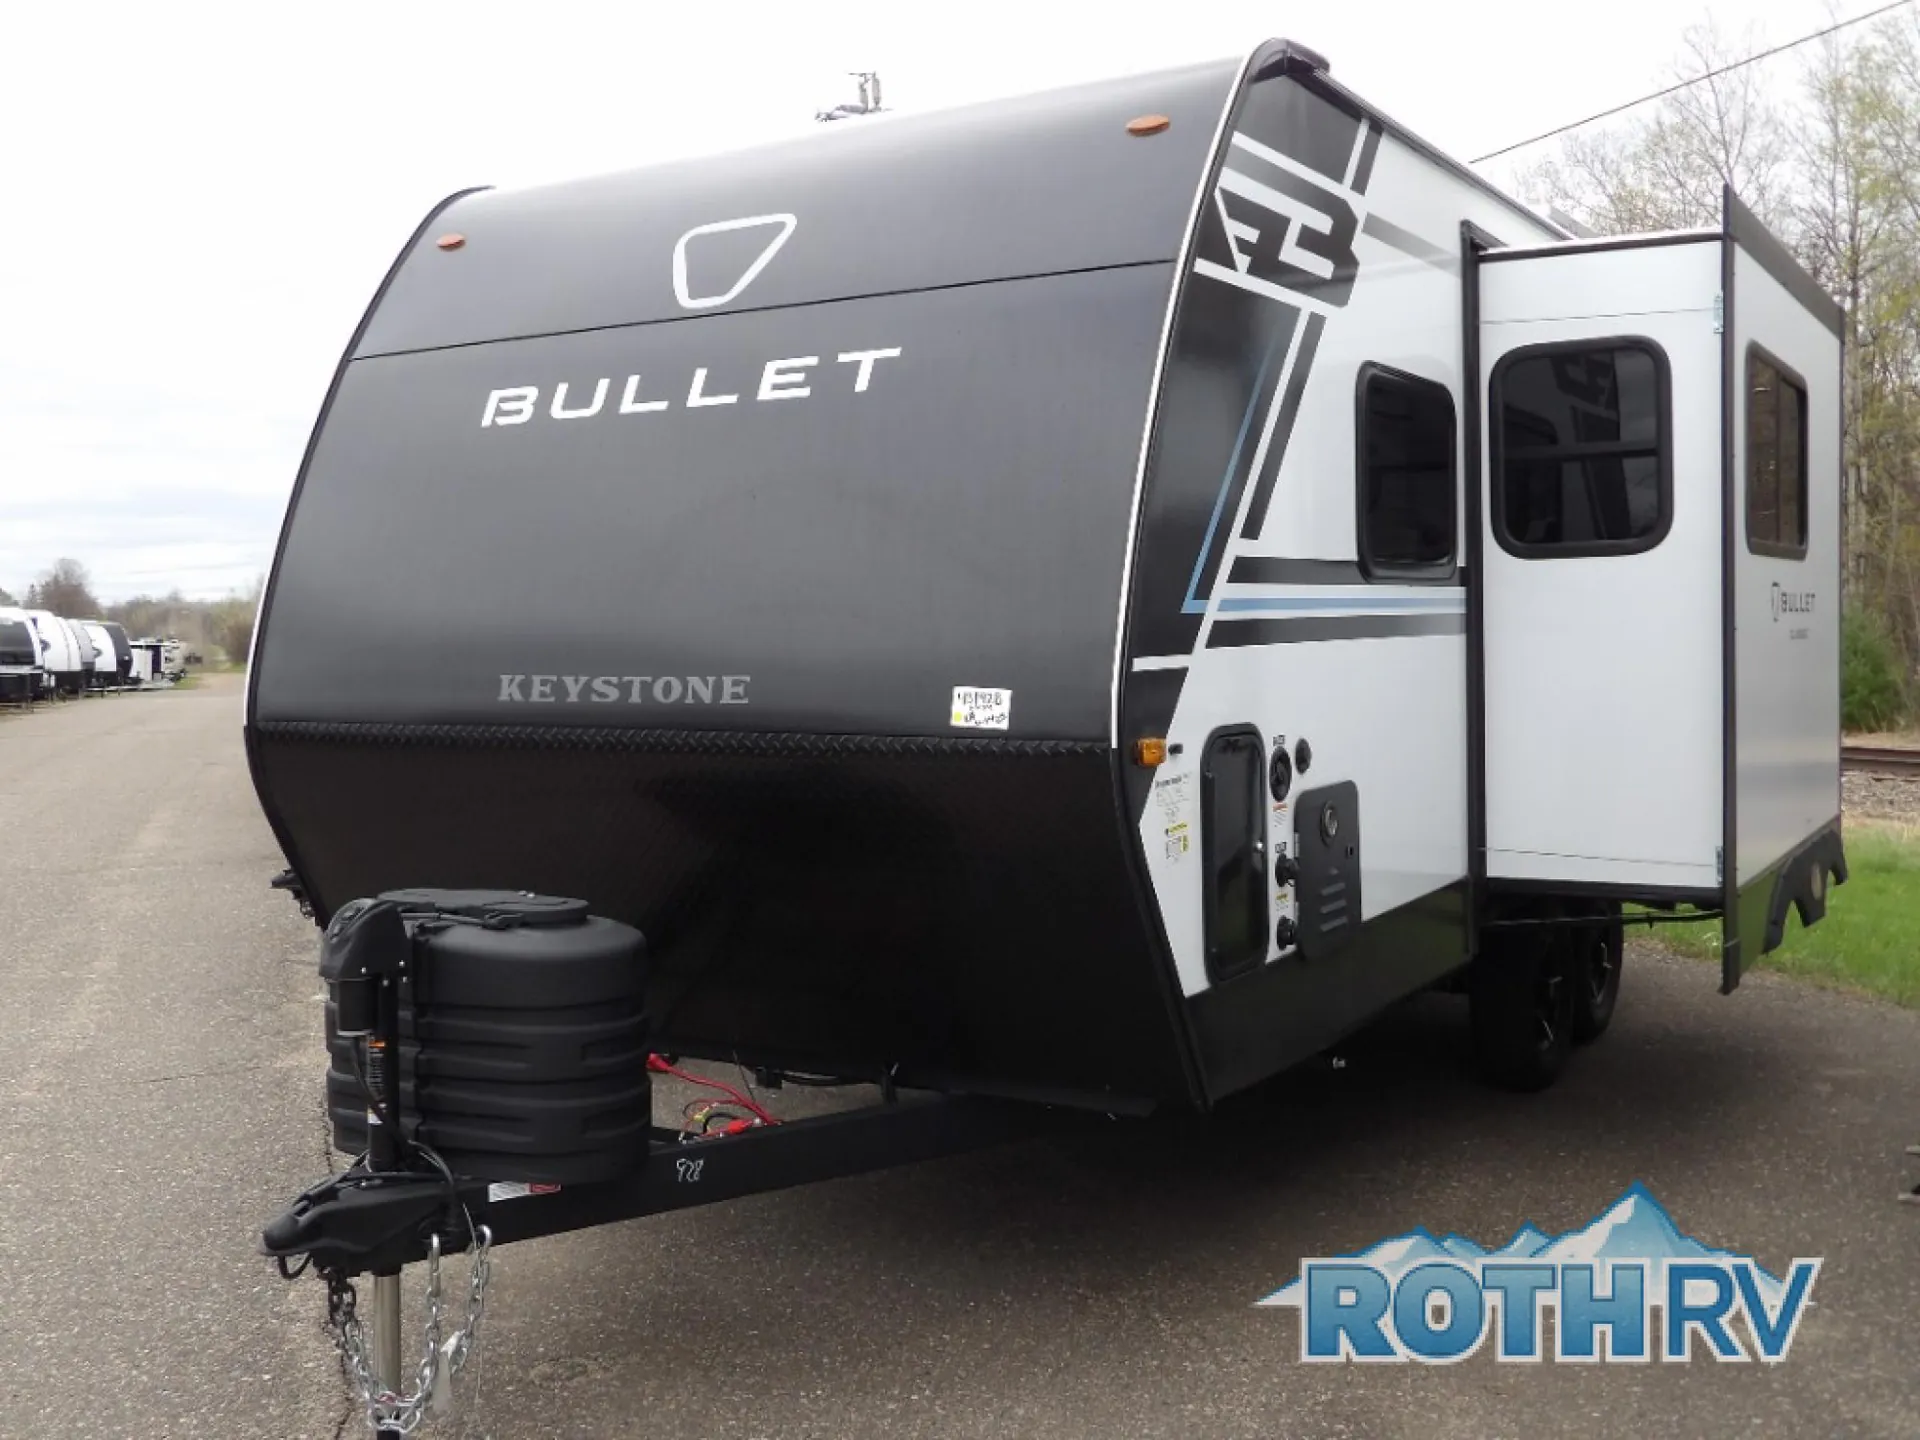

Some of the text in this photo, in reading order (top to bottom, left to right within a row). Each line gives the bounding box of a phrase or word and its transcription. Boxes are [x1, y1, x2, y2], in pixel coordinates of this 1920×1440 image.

[481, 347, 902, 428] BULLET
[1780, 591, 1816, 613] BULLET
[498, 674, 751, 704] KEYSTONE
